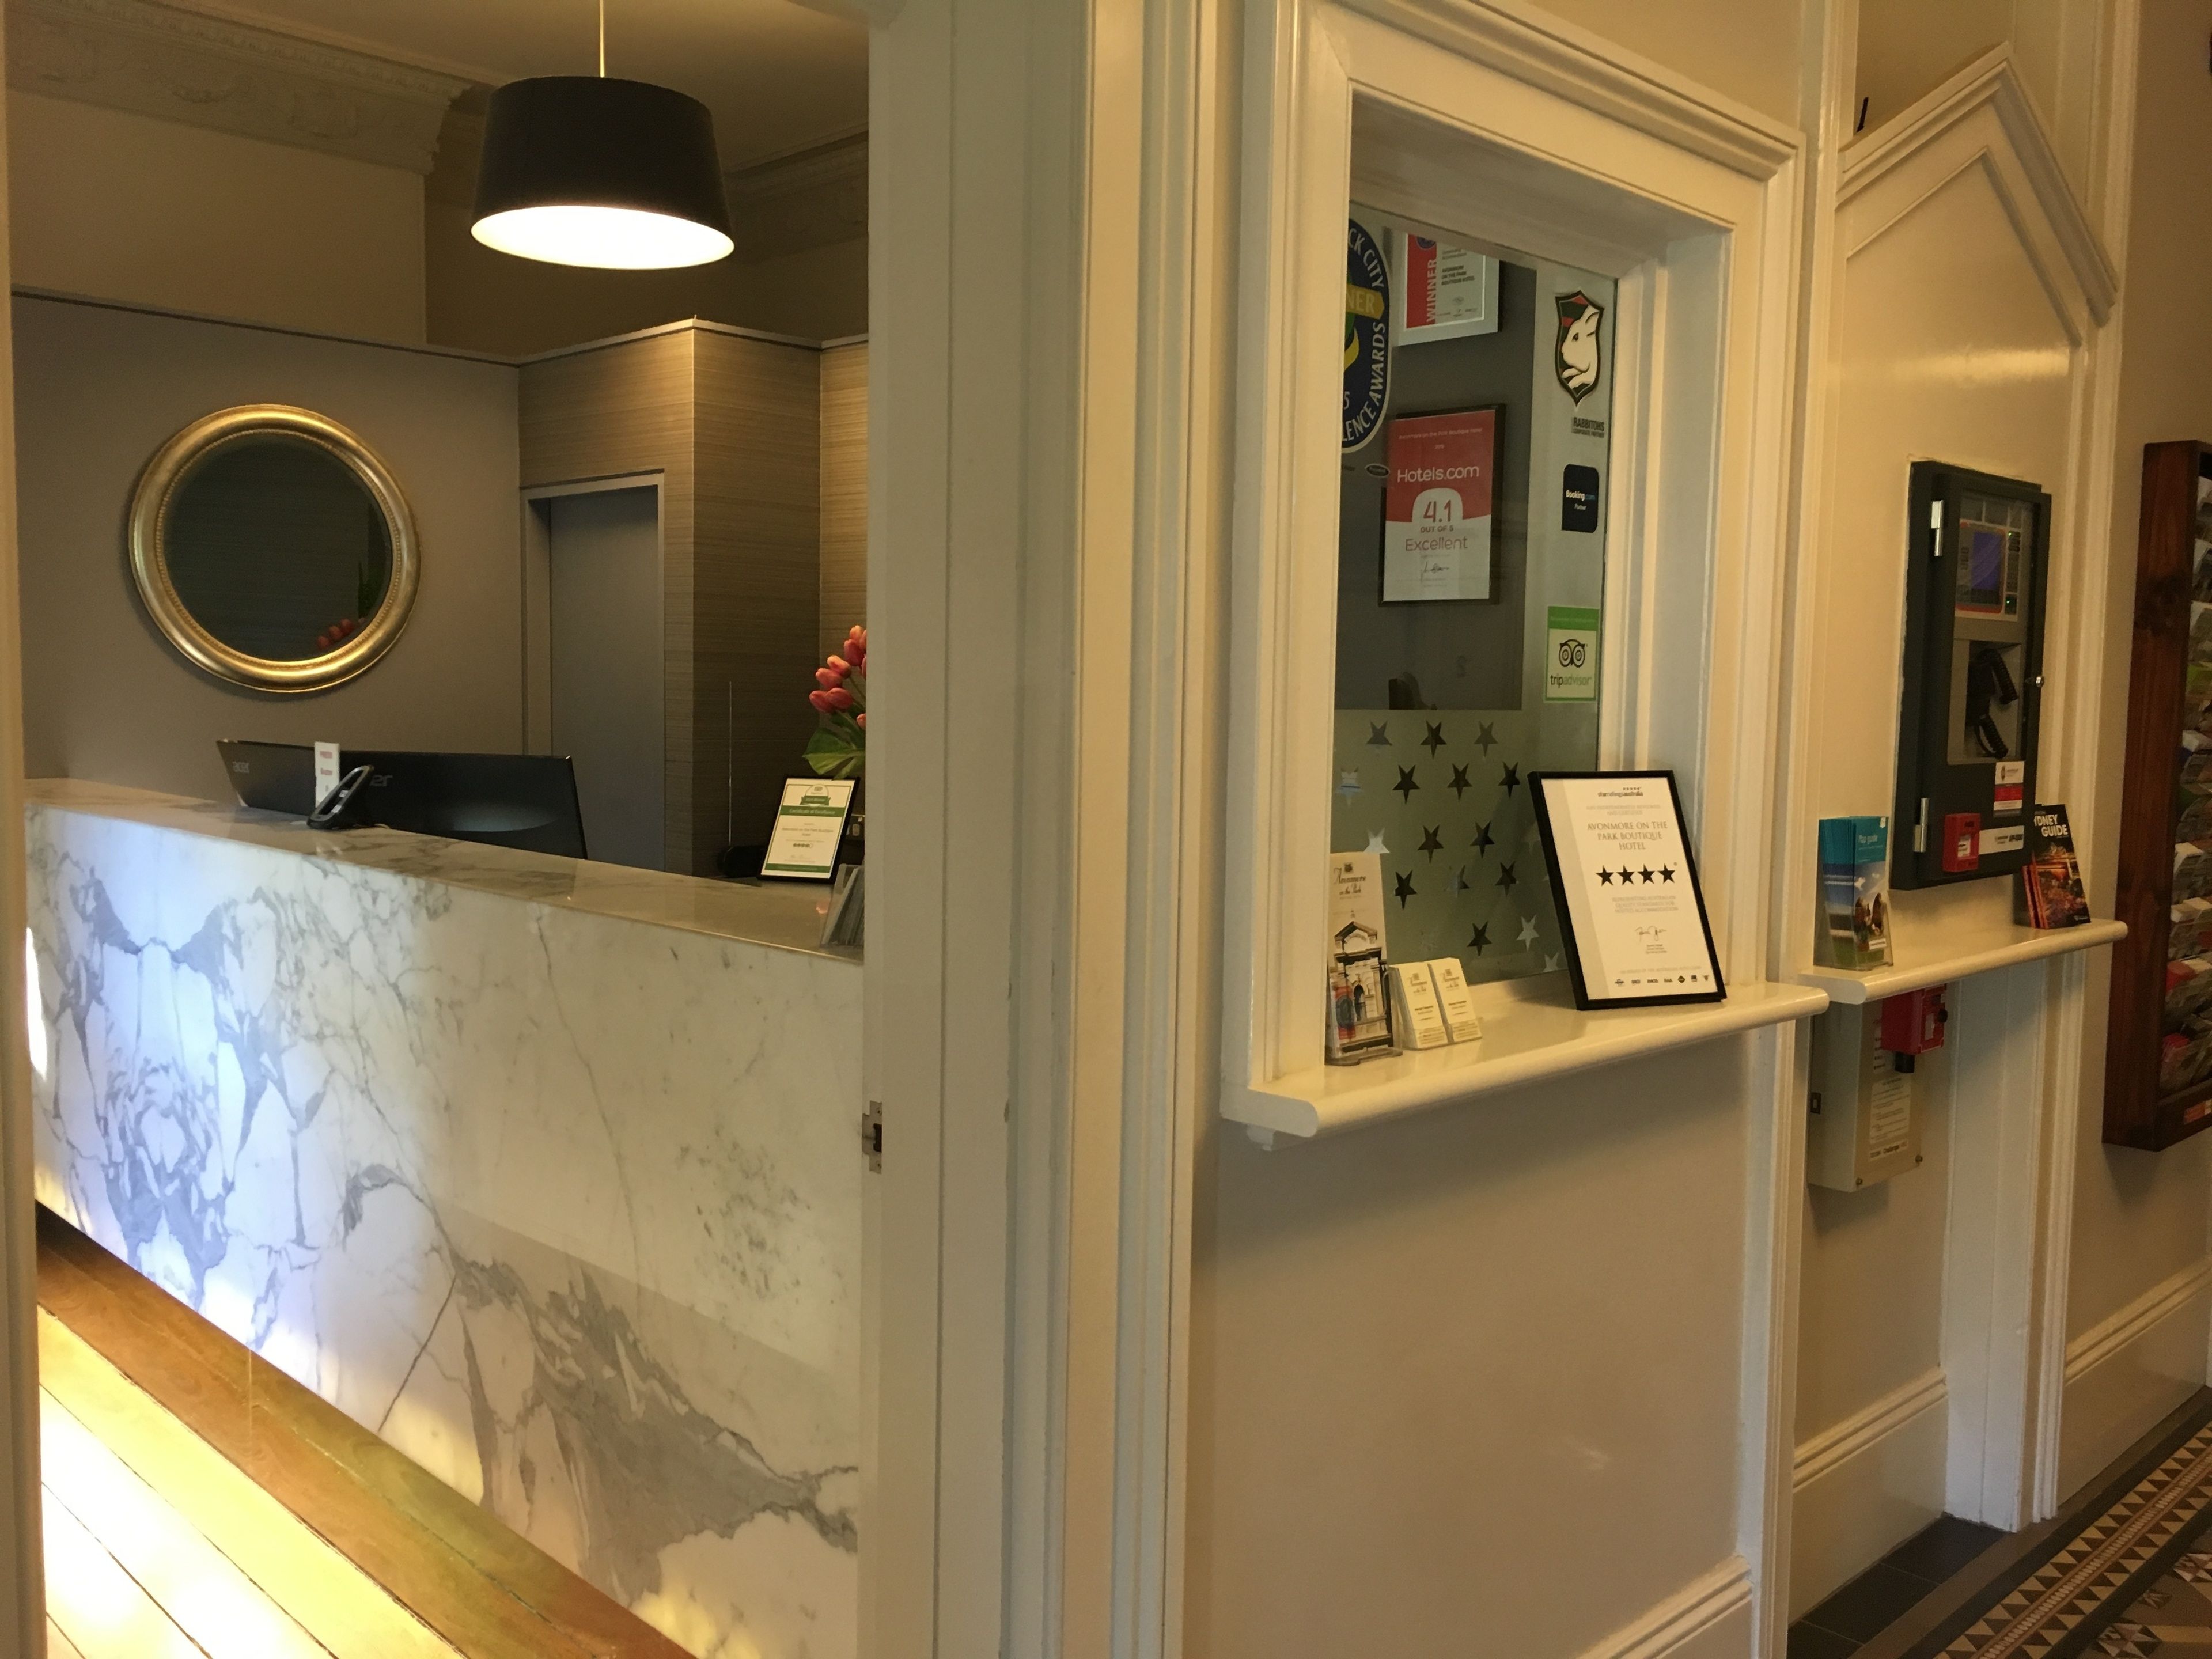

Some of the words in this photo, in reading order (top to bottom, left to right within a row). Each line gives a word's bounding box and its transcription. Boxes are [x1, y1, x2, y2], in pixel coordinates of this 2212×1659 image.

[1363, 249, 1384, 287] CITY
[1426, 259, 1437, 323] WINNER
[1369, 321, 1385, 406] AWARDS
[1573, 417, 1605, 431] RABBITOHS
[1397, 466, 1479, 483] Hotels.com
[1423, 499, 1452, 523] 4.1
[1406, 536, 1468, 551] Excellent
[1550, 673, 1592, 688] tripadvisor
[1588, 822, 1634, 831] AVONMORE
[1651, 821, 1668, 829] THE
[2041, 824, 2069, 838] GUIDE
[1597, 832, 1618, 840] PARK
[1620, 831, 1662, 841] BOUTIQUE
[1619, 842, 1646, 850] HOTEL
